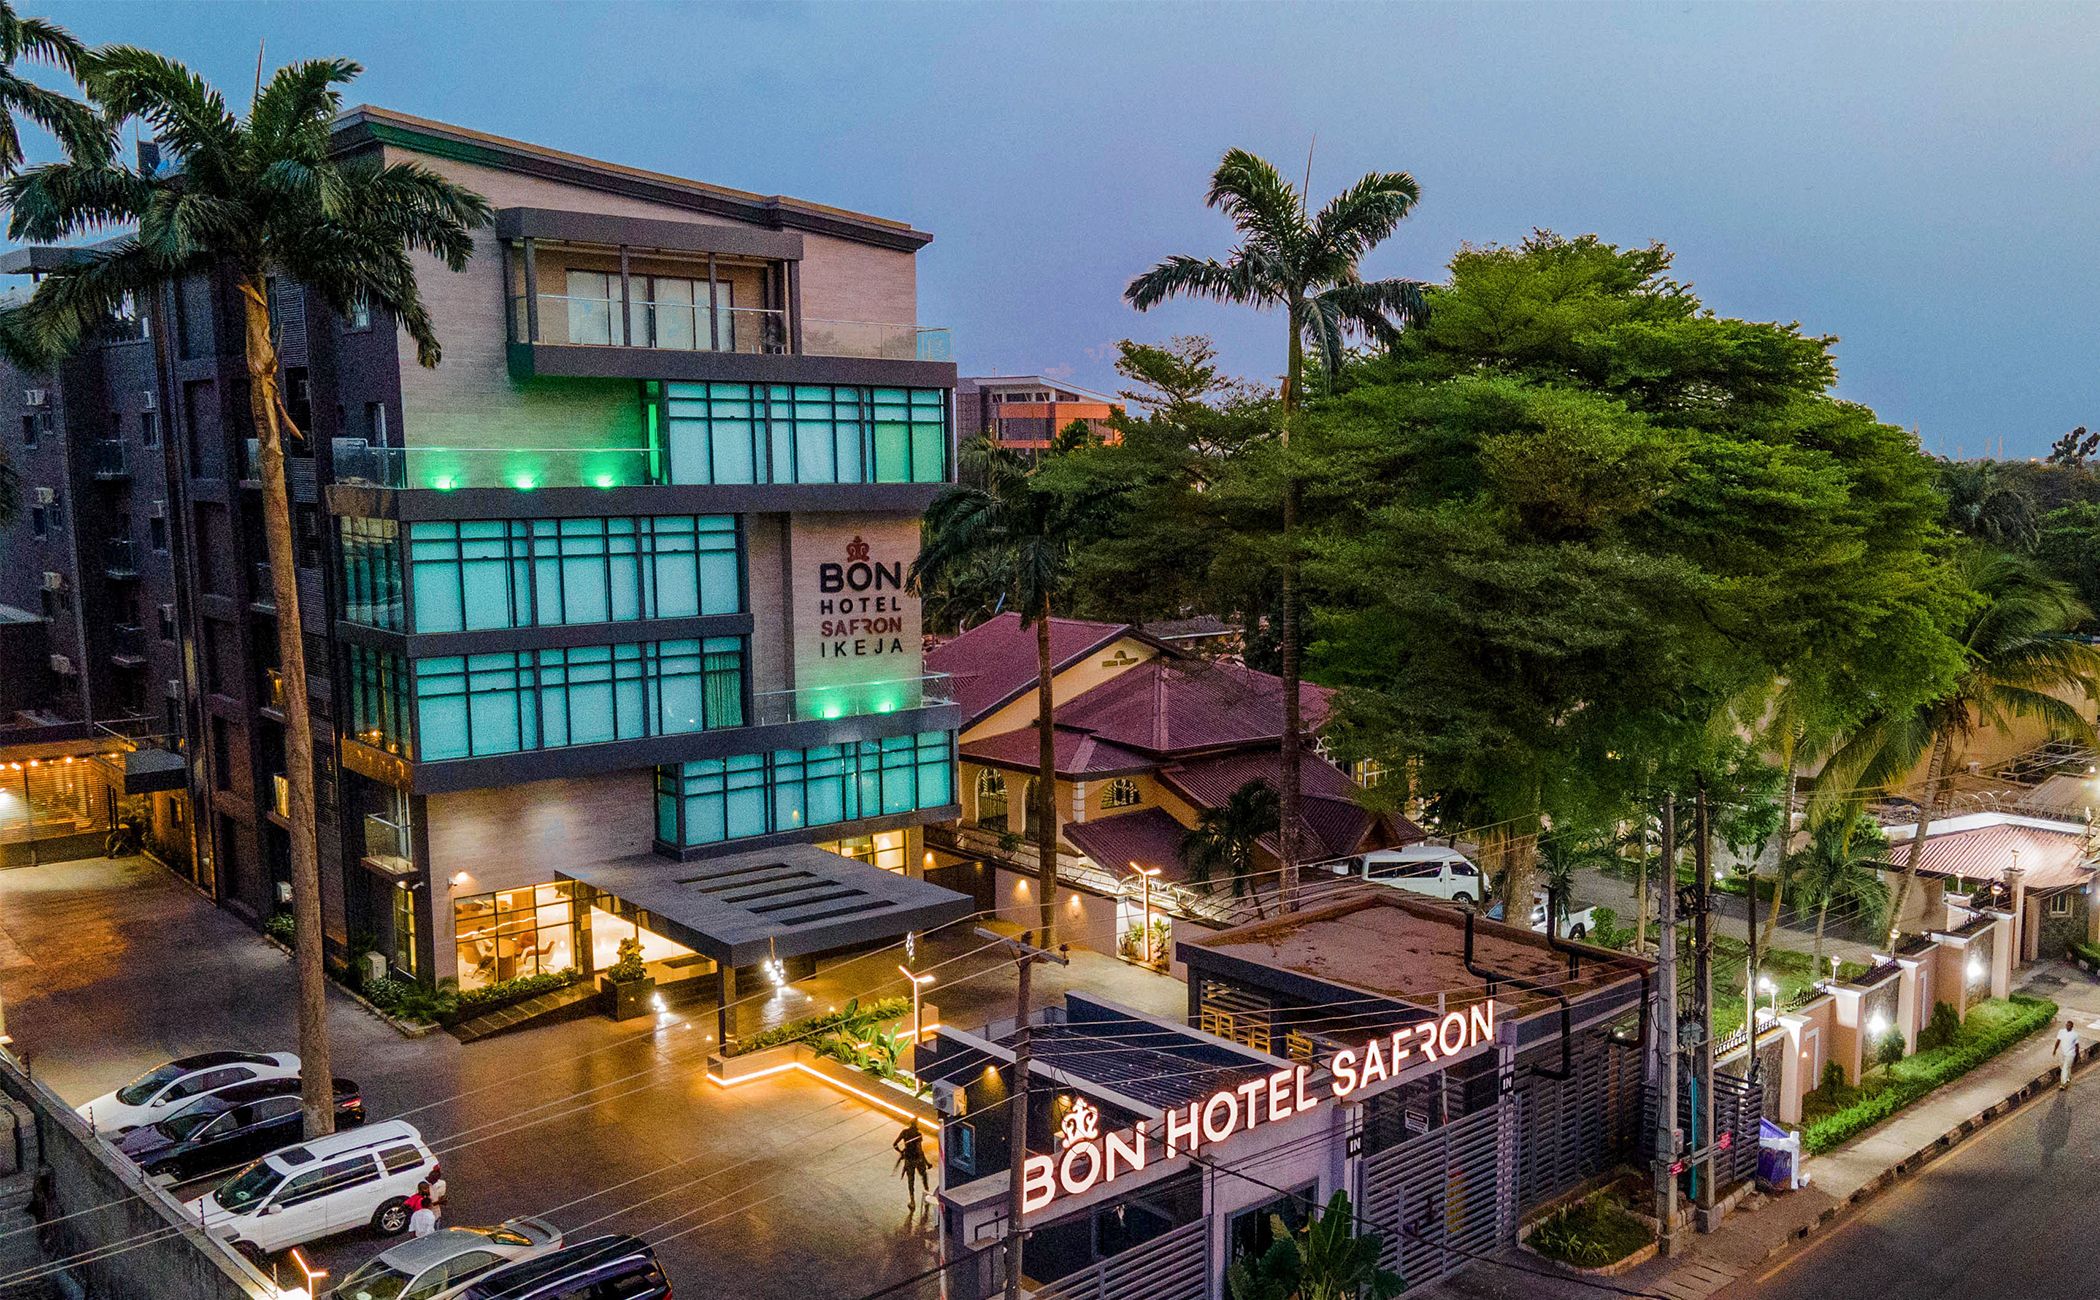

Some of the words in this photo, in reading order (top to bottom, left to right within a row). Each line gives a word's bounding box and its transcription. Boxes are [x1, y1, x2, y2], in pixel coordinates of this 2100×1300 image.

[820, 561, 901, 593] BON
[821, 597, 901, 615] HOTEL
[821, 617, 902, 637] SAFRON
[821, 638, 903, 658] IKEJA
[1502, 1076, 1512, 1091] IN
[1022, 1121, 1146, 1214] BON
[1166, 1065, 1318, 1159] HOTEL
[1331, 999, 1495, 1097] SAFRON
[1350, 1137, 1361, 1153] IN
